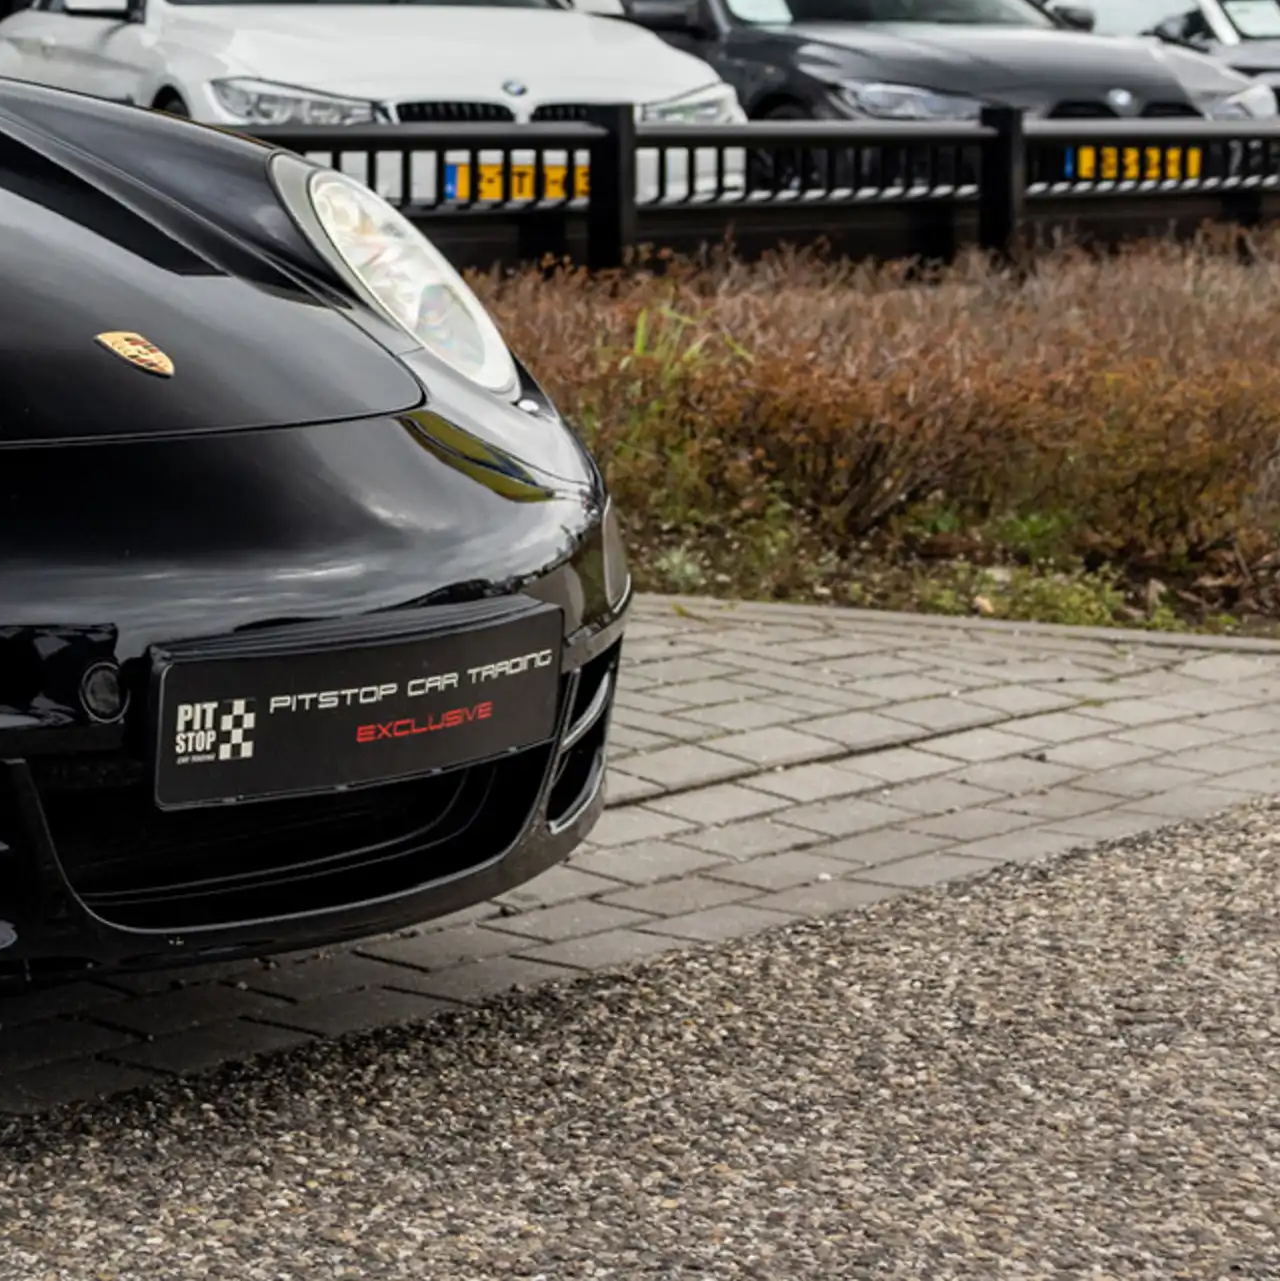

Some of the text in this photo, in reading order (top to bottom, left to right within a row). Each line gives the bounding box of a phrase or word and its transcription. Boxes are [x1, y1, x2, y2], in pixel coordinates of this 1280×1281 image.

[268, 649, 554, 714] PITSTOP CAR TRADING
[176, 701, 219, 733] PIT
[355, 701, 494, 743] EXCLUSIVE
[175, 729, 218, 754] STOP
